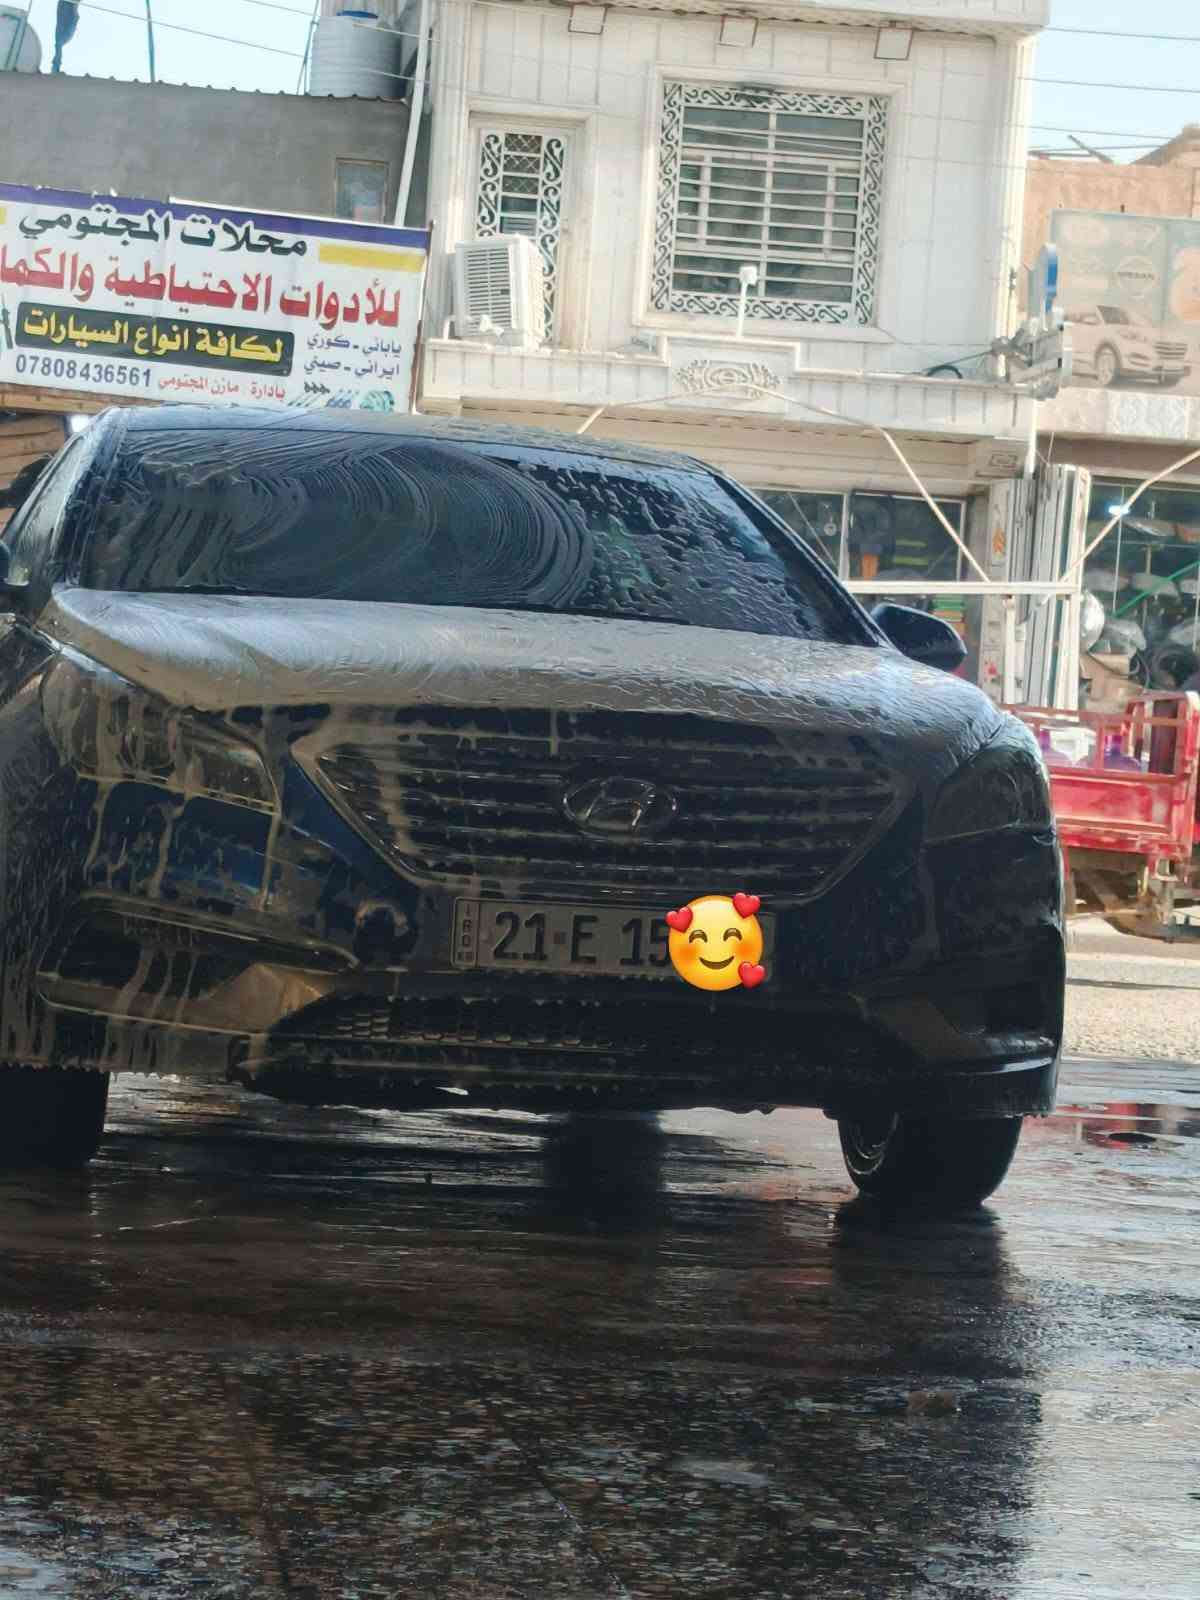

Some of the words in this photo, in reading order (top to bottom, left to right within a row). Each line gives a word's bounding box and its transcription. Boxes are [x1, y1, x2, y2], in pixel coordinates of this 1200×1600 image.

[18, 206, 171, 246] المجتومي
[180, 217, 308, 257] محلات
[104, 255, 273, 315] الاحتياطية
[279, 278, 401, 331] للأدوات
[24, 308, 129, 349] السيارات
[134, 324, 189, 356] انواع
[195, 328, 284, 363] لكافة
[16, 354, 152, 388] 07808436561
[494, 911, 547, 963] 21
[571, 914, 598, 963] E
[619, 917, 669, 967] 15
